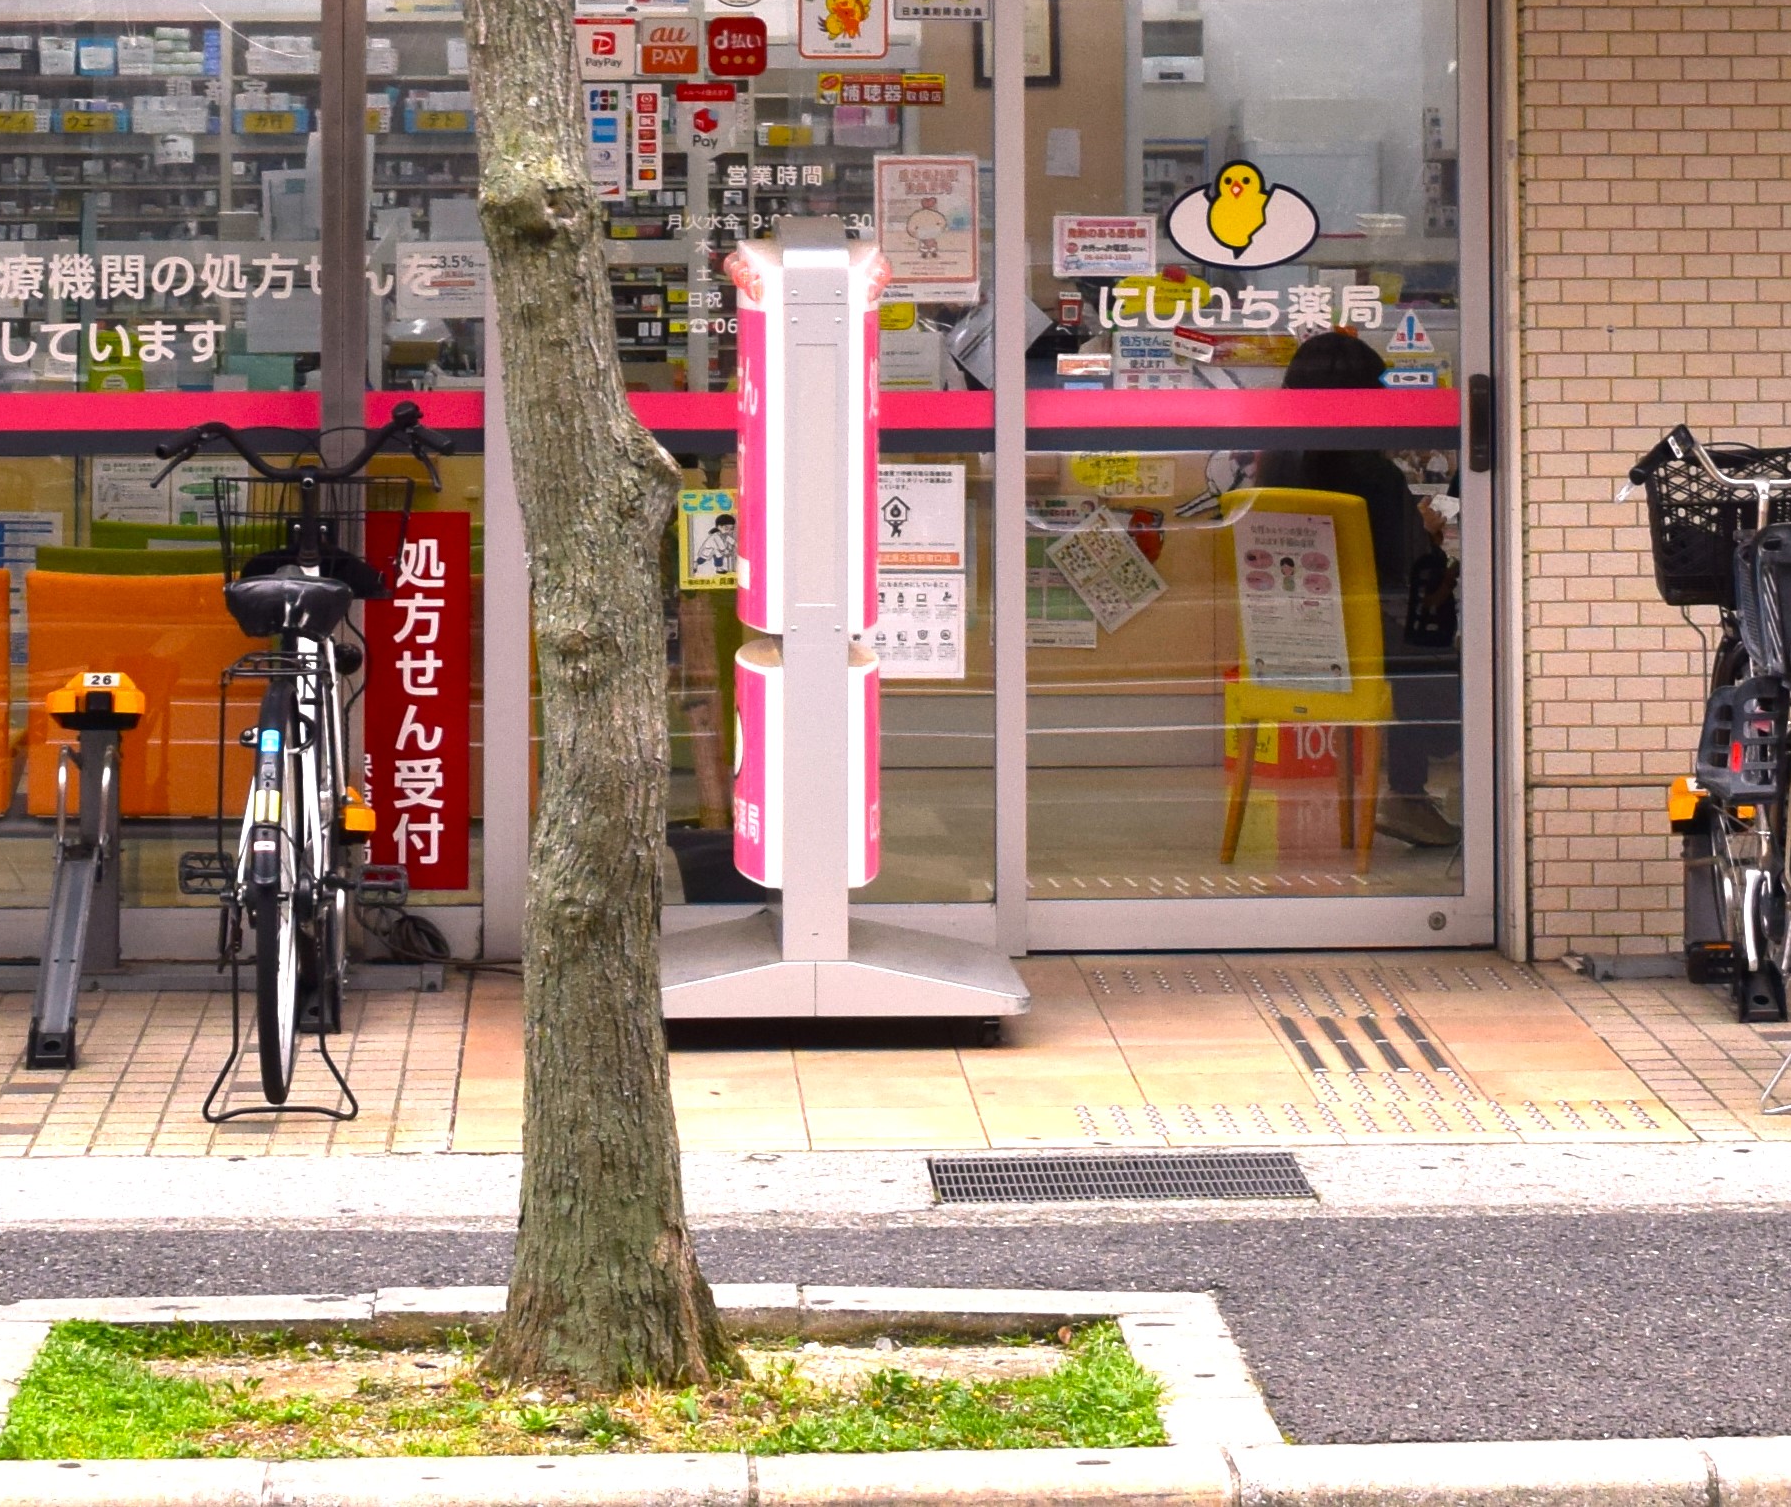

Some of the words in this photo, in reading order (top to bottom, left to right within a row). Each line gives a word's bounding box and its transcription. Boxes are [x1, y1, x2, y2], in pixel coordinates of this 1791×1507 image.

[902, 7, 982, 17] 日本薬剤師会会員
[649, 26, 690, 44] au
[713, 29, 762, 50] d払い
[585, 57, 623, 69] PayPay
[651, 49, 689, 65] PAY
[842, 83, 902, 102] 補聴器
[692, 134, 719, 150] Pay
[727, 165, 823, 187] 営業時間
[666, 213, 741, 231] 月火水金
[694, 239, 713, 254] 木
[696, 267, 713, 283] 土
[688, 292, 723, 309] 日祝
[1098, 284, 1384, 329] にしいち薬局
[1395, 332, 1425, 342] 注意
[682, 492, 733, 512] こども
[90, 674, 112, 686] 26
[392, 538, 446, 866] 処方せん受付
